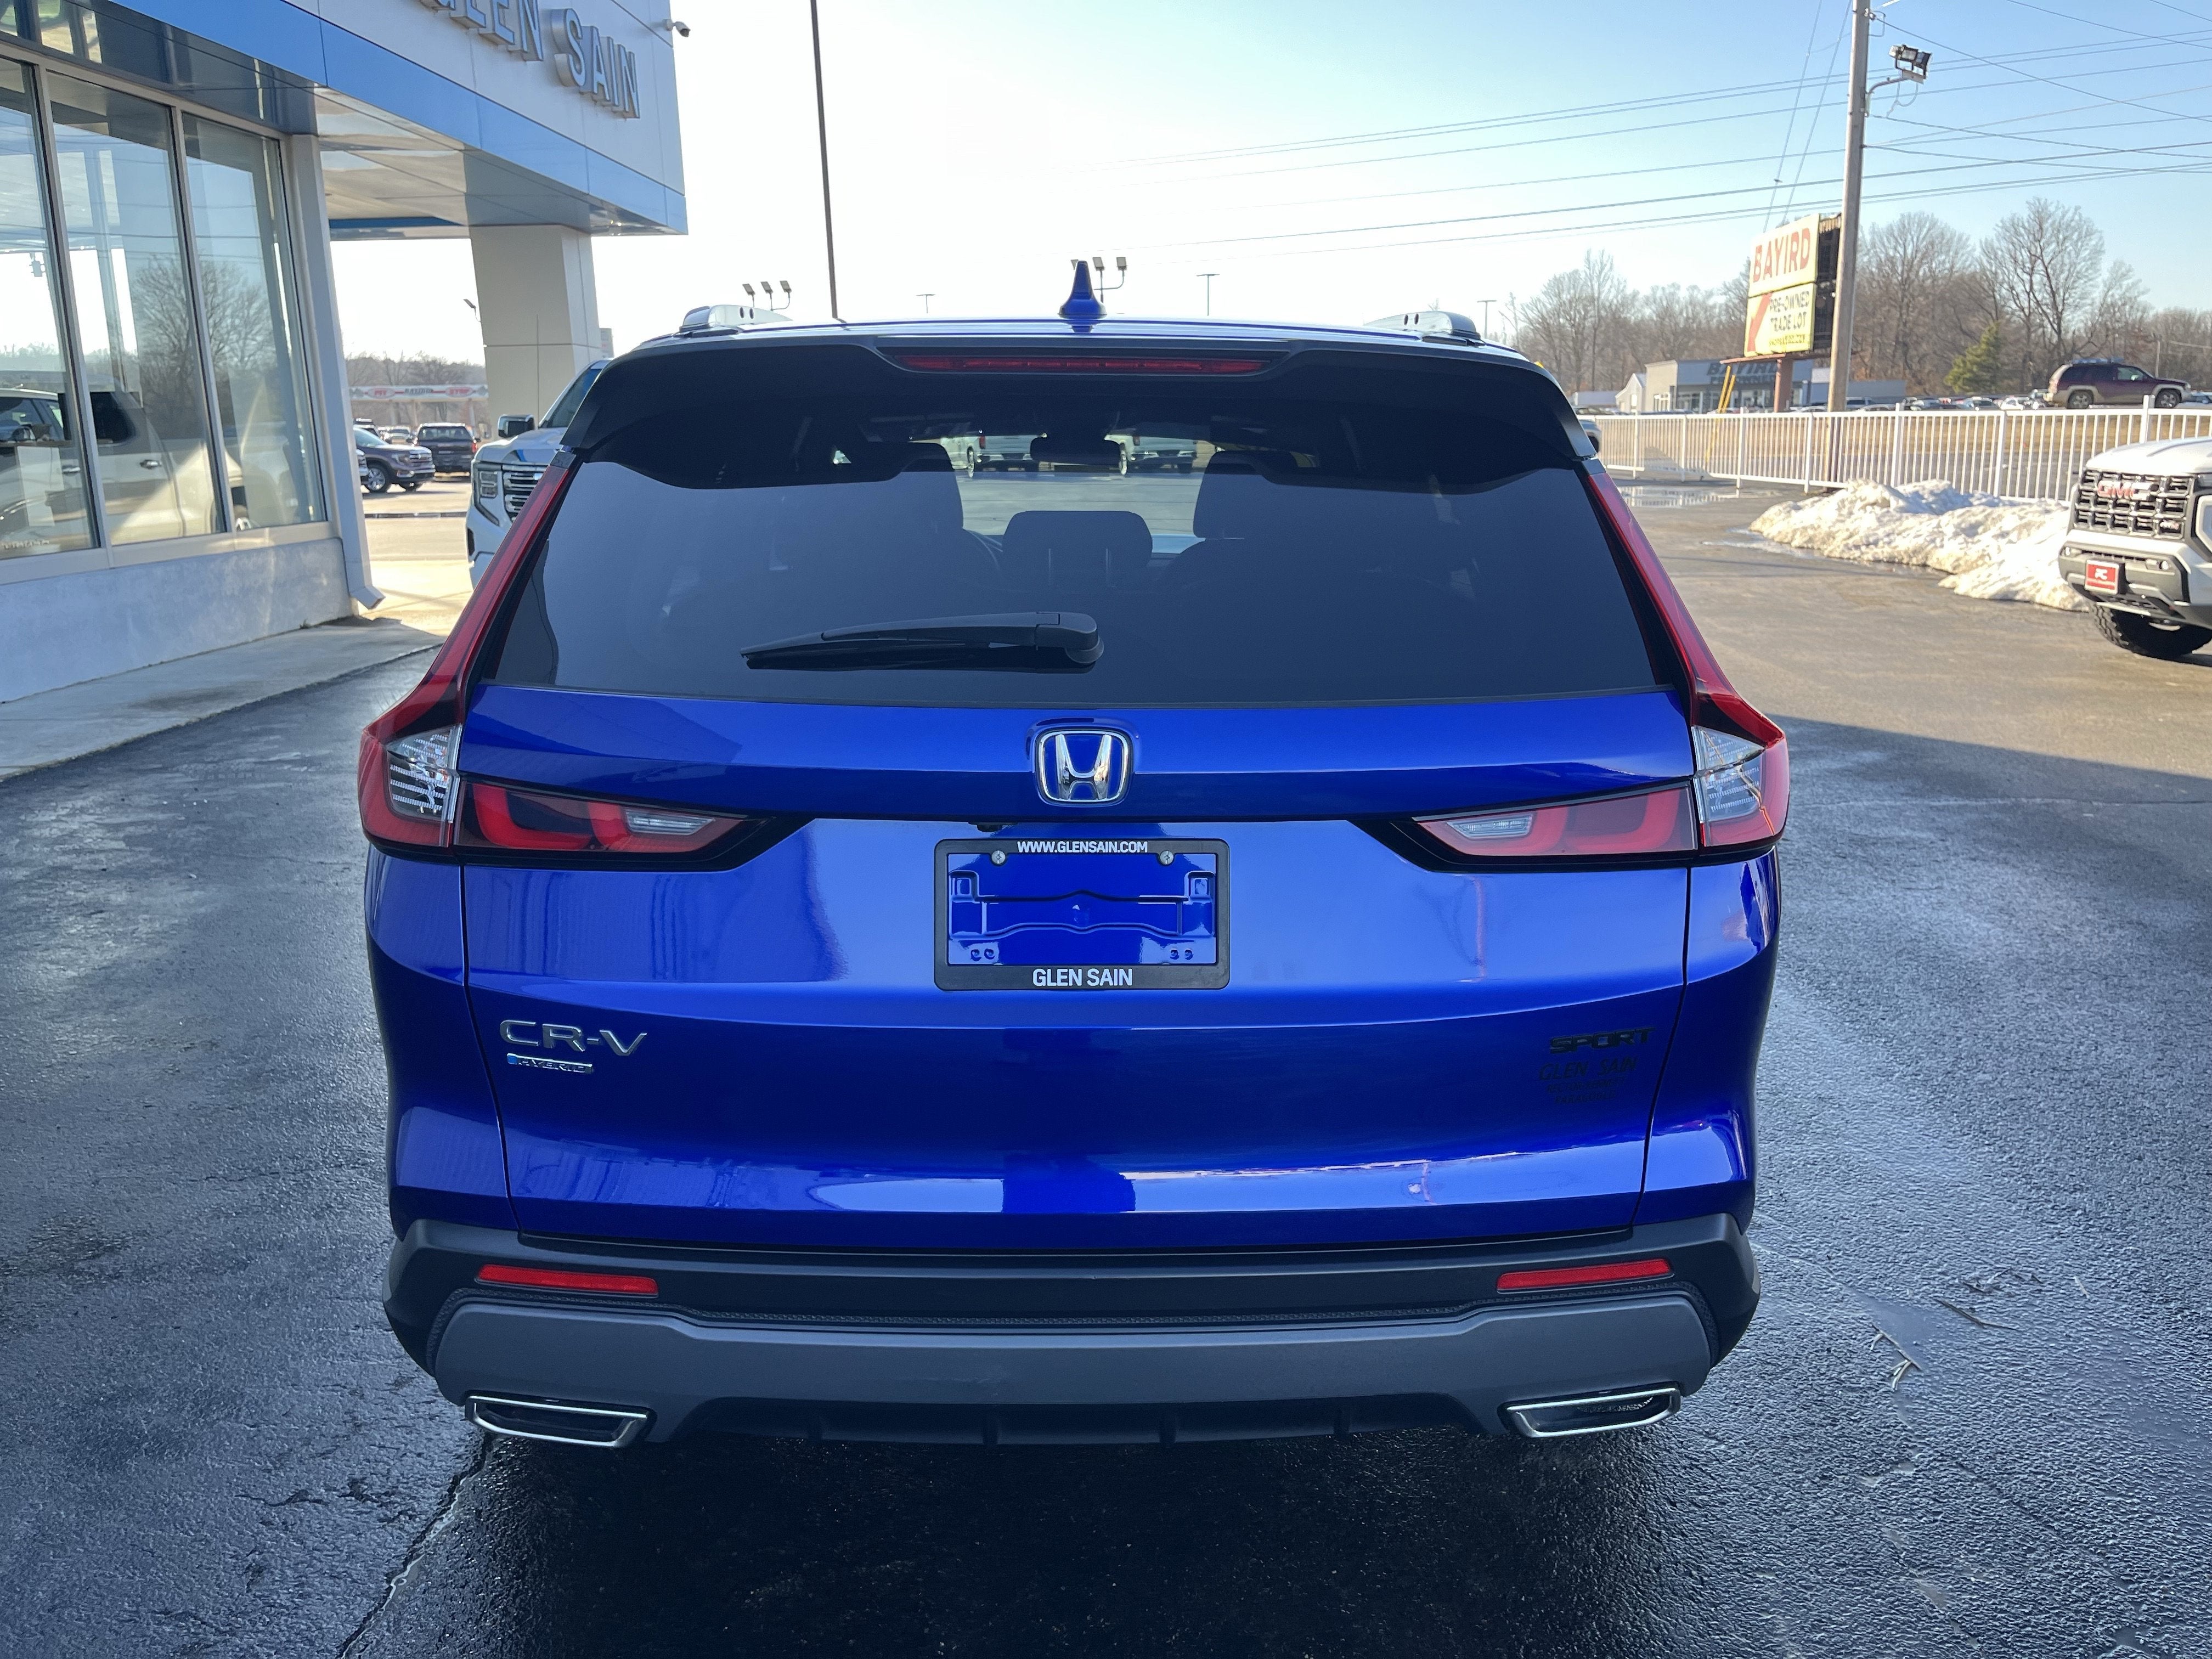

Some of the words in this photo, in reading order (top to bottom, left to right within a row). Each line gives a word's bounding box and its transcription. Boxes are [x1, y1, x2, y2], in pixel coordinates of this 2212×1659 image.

[551, 8, 640, 119] SAIN
[1752, 227, 1810, 283] BAYIRD
[1793, 311, 1807, 329] LOT
[2097, 480, 2154, 501] GMC
[1017, 841, 1148, 854] WWW.GLENSAIN.COM
[1032, 968, 1082, 987] GLEN
[1086, 968, 1133, 987] SAIN
[499, 1019, 647, 1056] CR-V
[1550, 1026, 1656, 1054] SPORT
[1538, 1060, 1589, 1081] GLEN
[1597, 1056, 1639, 1076] SAIN
